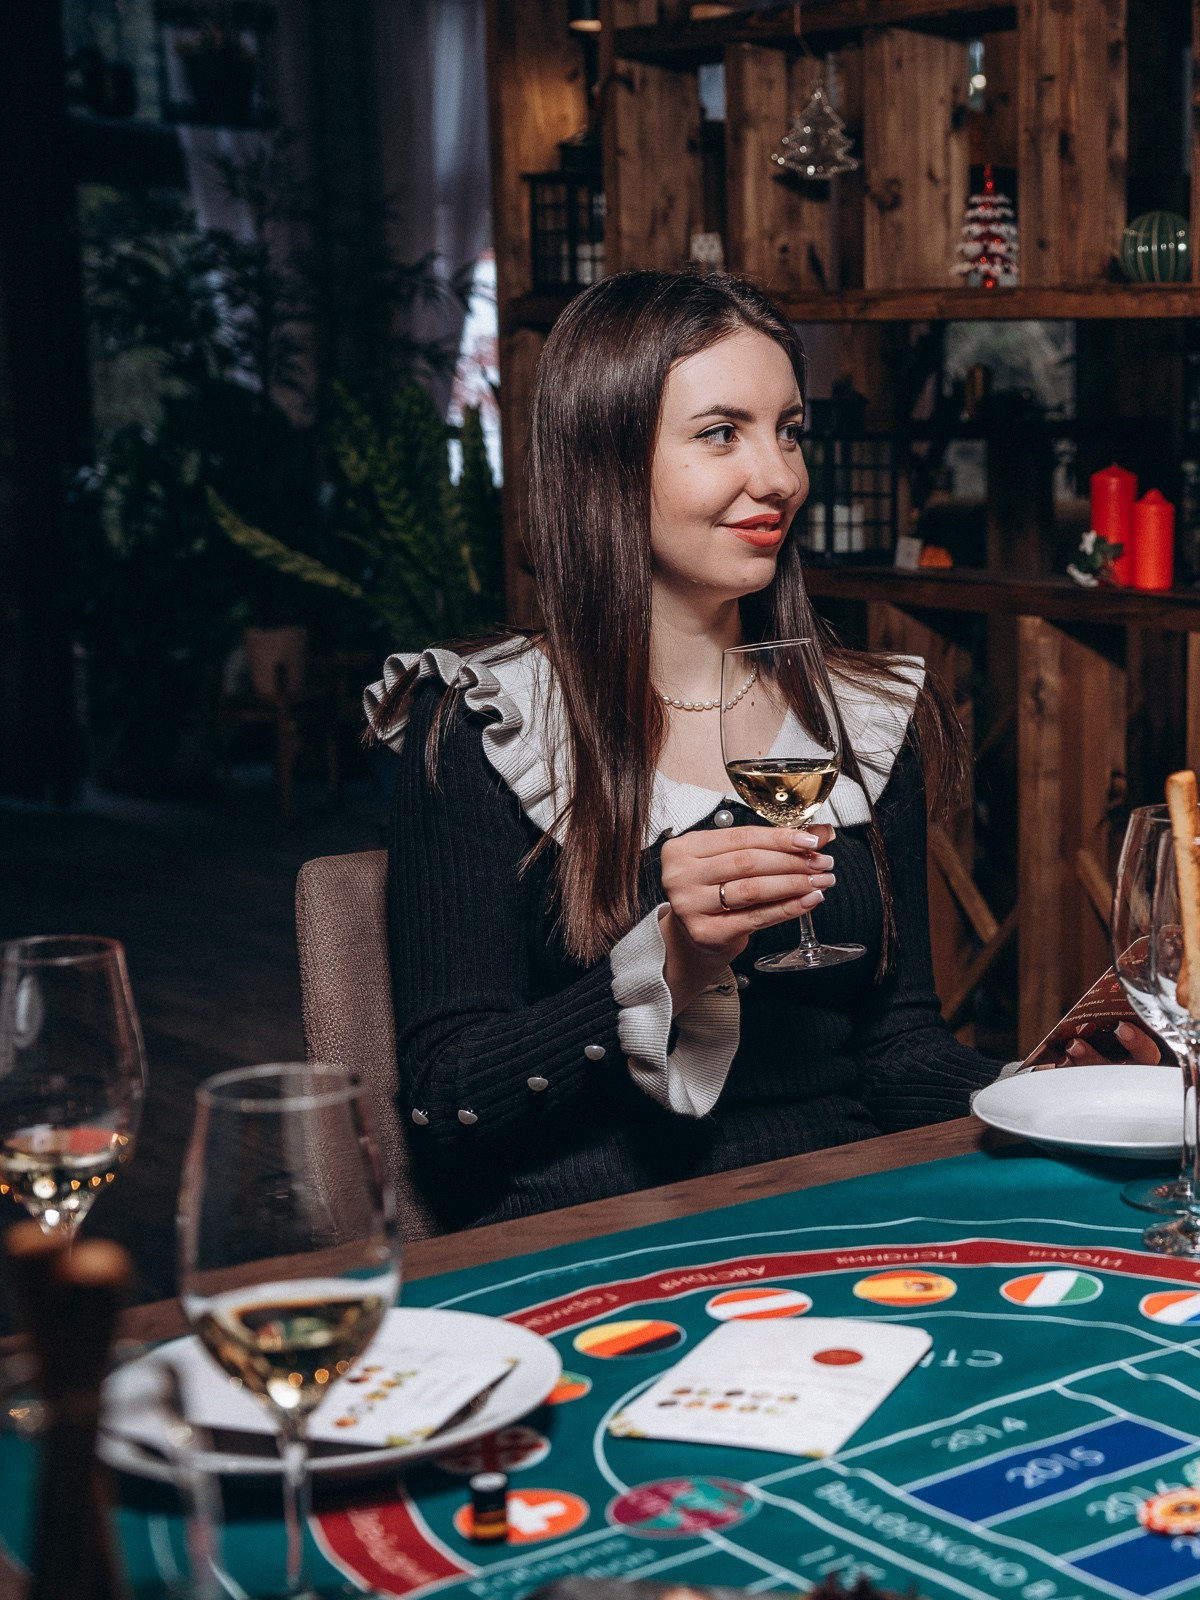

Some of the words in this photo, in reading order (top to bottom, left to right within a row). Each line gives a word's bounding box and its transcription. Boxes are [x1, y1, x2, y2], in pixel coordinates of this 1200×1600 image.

[836, 1250, 958, 1264] Испания
[1027, 1249, 1122, 1268] Италия
[660, 1265, 766, 1292] Австрия
[931, 1416, 1028, 1452] 2014
[1005, 1446, 1105, 1488] 2015
